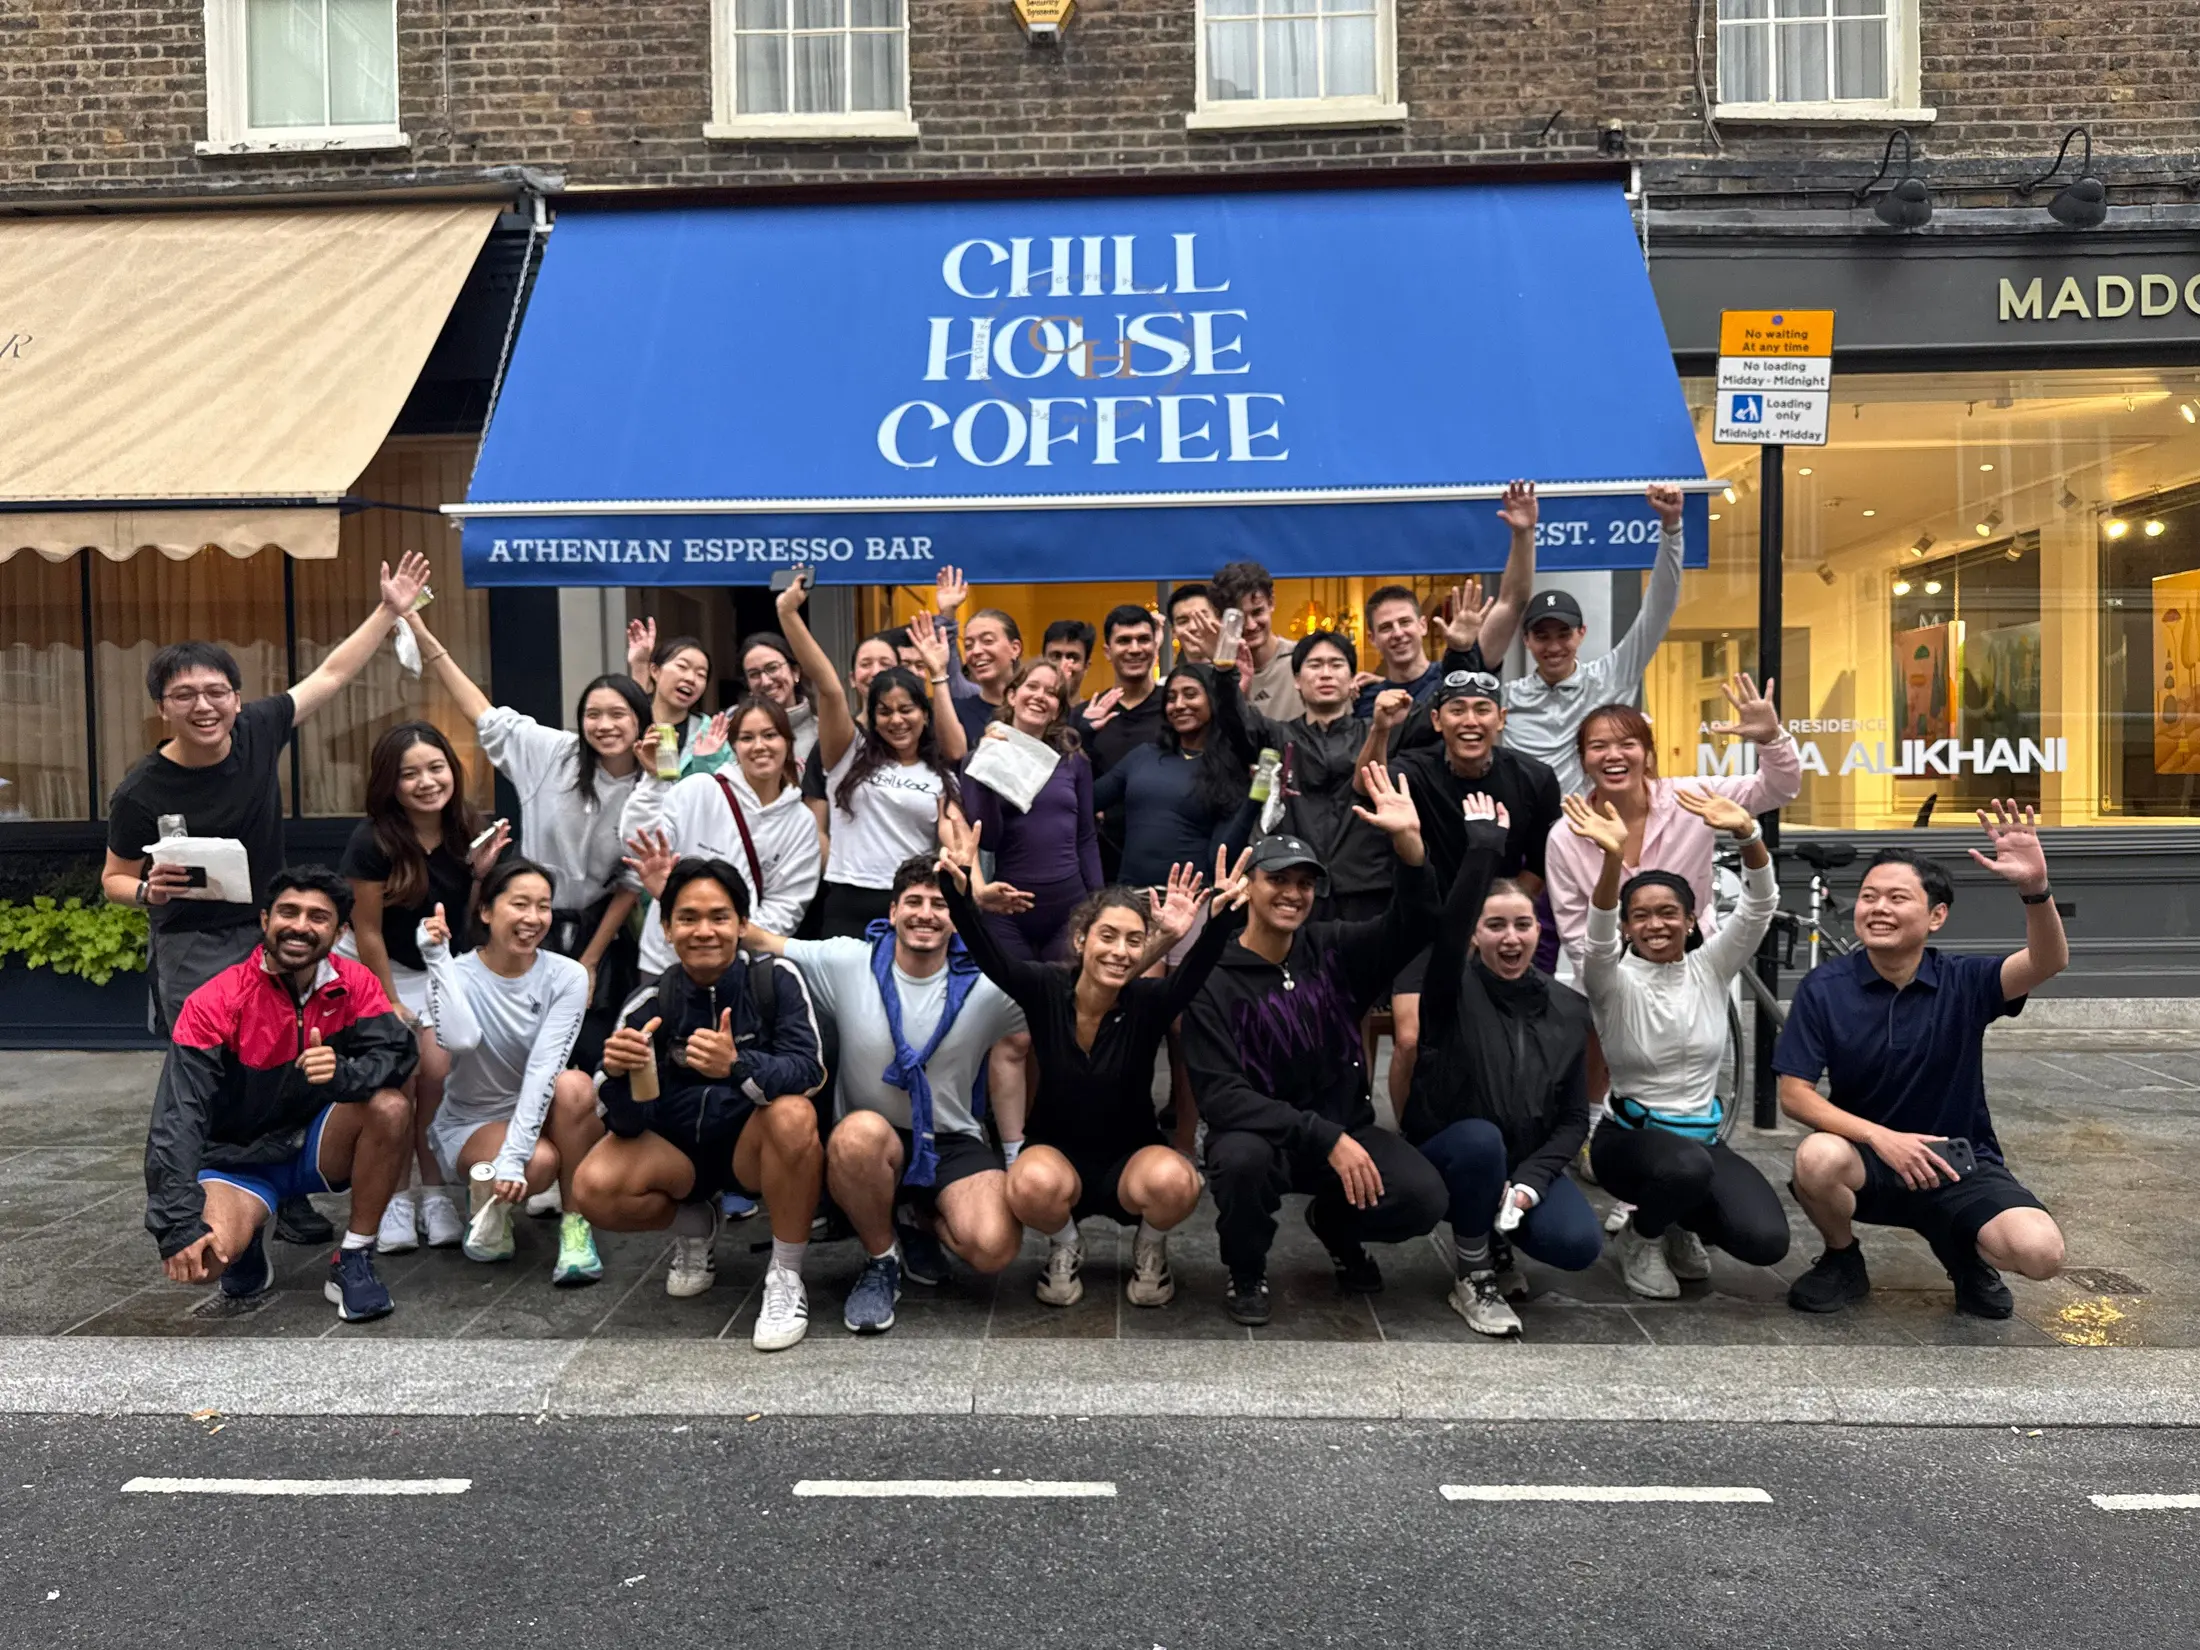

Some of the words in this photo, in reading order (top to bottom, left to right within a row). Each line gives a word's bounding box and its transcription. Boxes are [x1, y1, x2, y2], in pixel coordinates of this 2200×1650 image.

[942, 233, 1231, 300] CHILL
[1745, 329, 1762, 339] No
[1765, 329, 1808, 340] waiting
[922, 309, 1252, 381] HOUSE
[1742, 342, 1756, 352] At
[1759, 344, 1780, 353] any
[1784, 342, 1810, 352] time
[1743, 361, 1760, 371] No
[1763, 361, 1807, 372] loading
[1722, 375, 1765, 386] Midday
[1773, 376, 1826, 388] Midnight
[1766, 399, 1812, 410] Loading
[1775, 410, 1801, 421] only
[877, 391, 1290, 470] COFFEE
[1719, 428, 1770, 440] Midnight
[1779, 429, 1822, 441] Midday
[1535, 520, 1597, 547] EST.
[488, 539, 673, 564] ATHENIAN
[682, 537, 855, 563] ESPRESSO
[864, 536, 935, 561] BAR
[1789, 718, 1887, 734] RESIDENCE
[1697, 741, 1830, 776] MIA
[1838, 737, 2068, 776] ALIKHANI
